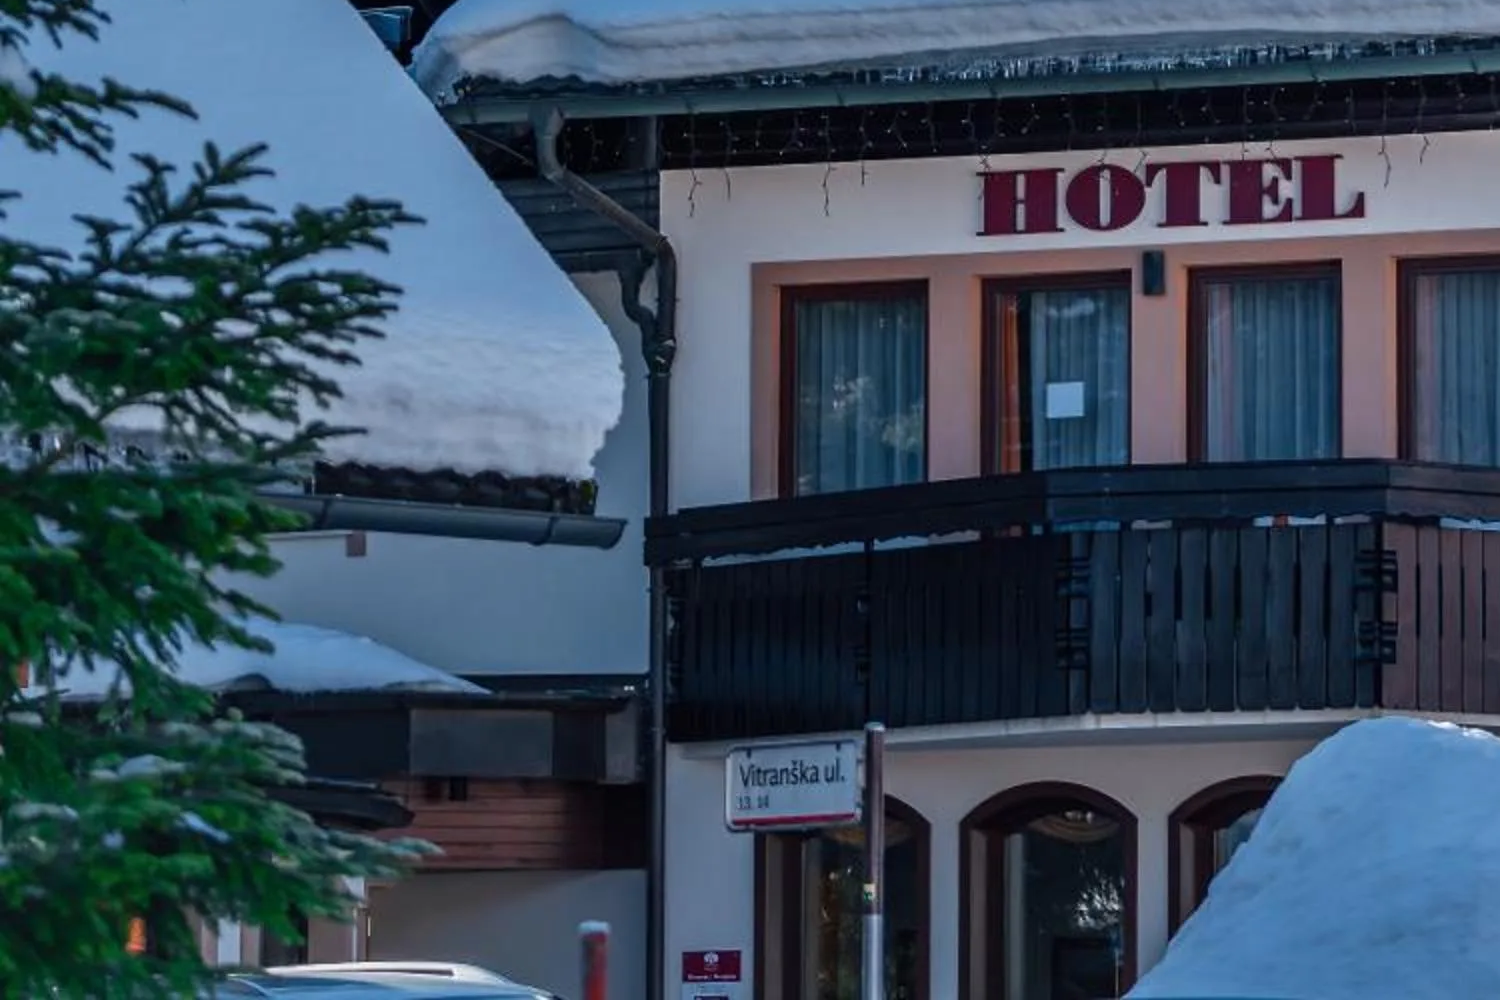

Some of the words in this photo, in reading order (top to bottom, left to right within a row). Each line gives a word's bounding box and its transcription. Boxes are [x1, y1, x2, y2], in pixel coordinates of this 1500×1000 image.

[976, 153, 1365, 237] HOTEL
[740, 760, 819, 788] Vitranška
[824, 758, 845, 783] ul.
